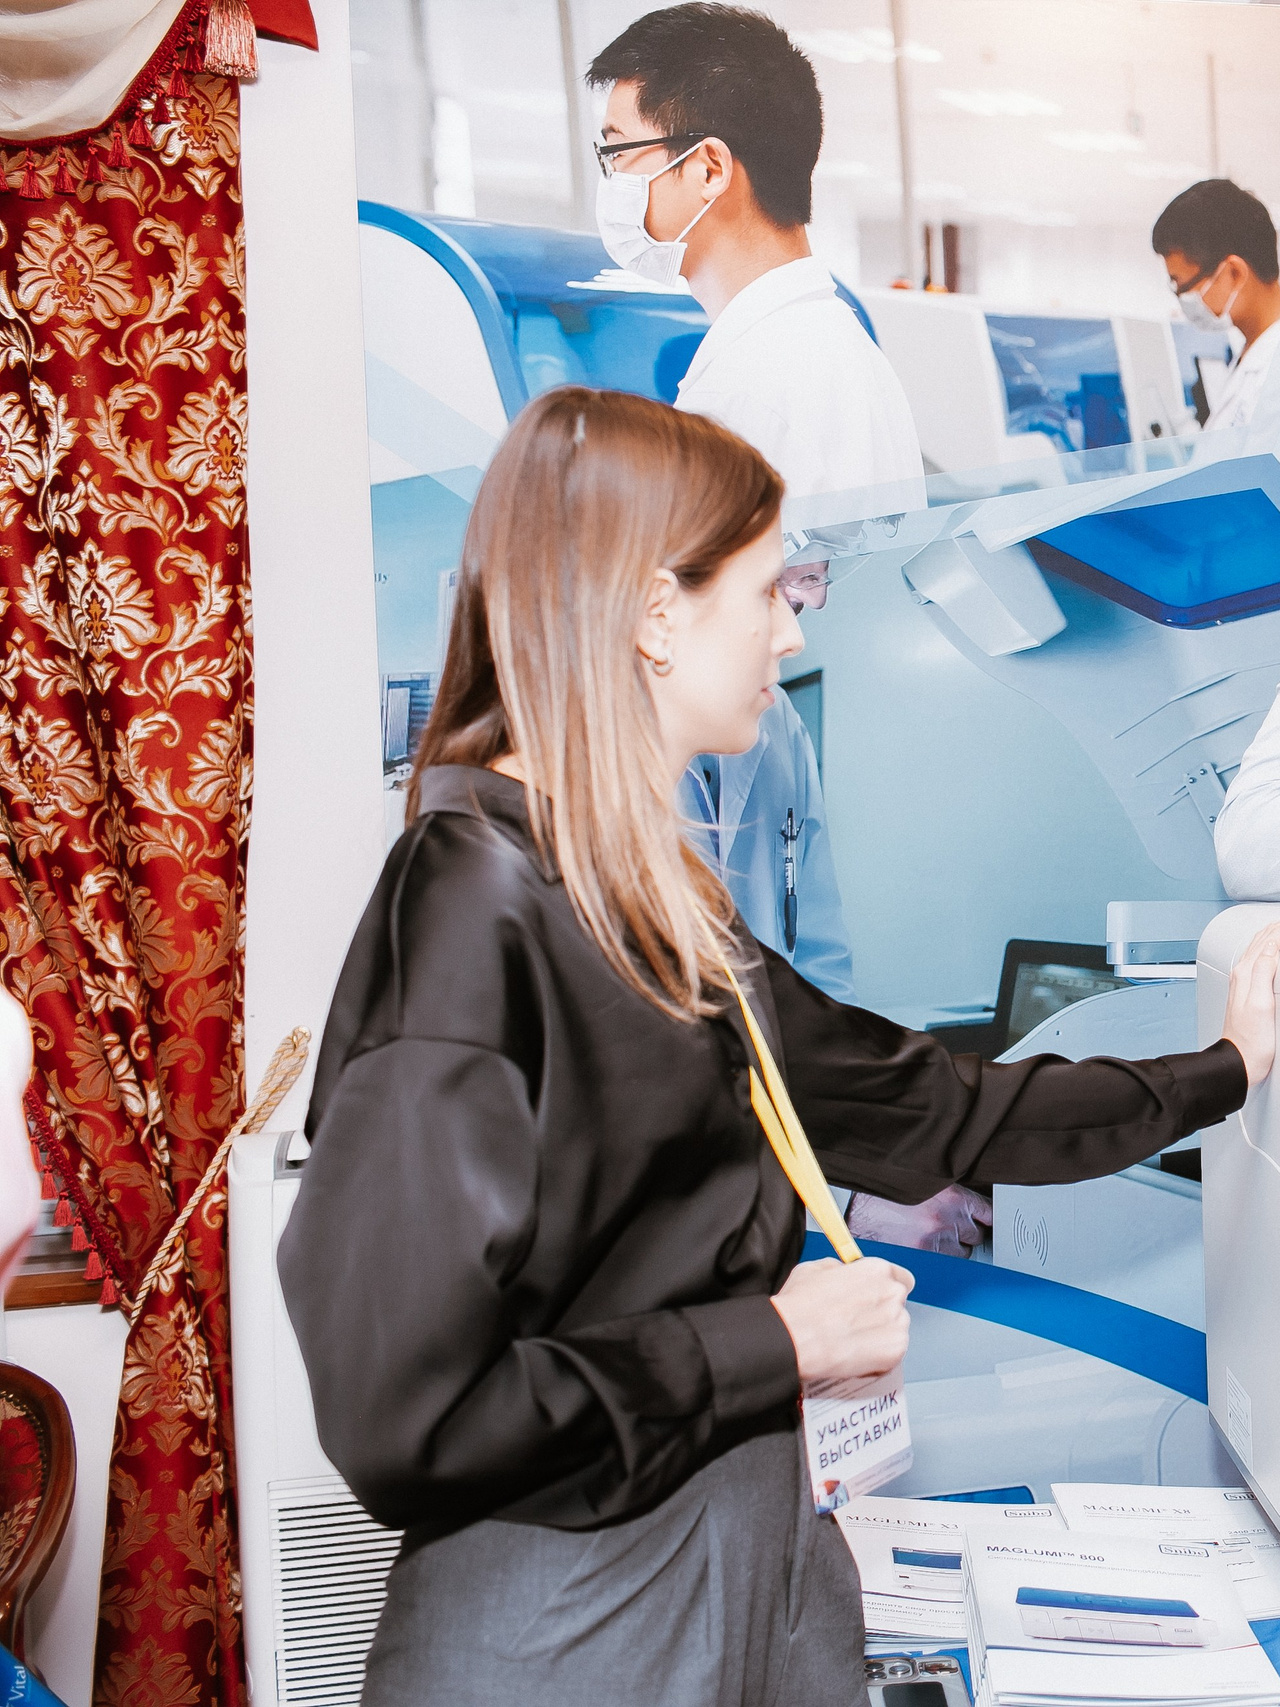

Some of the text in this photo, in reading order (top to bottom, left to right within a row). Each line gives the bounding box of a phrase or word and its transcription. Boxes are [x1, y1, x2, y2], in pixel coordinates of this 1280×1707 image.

[816, 1388, 899, 1446] УЧАСТНИК
[818, 1412, 902, 1470] ВЫСТАВКИ
[1079, 1554, 1105, 1563] 800
[1164, 1546, 1205, 1556] Snibe
[8, 1665, 27, 1701] Vital
